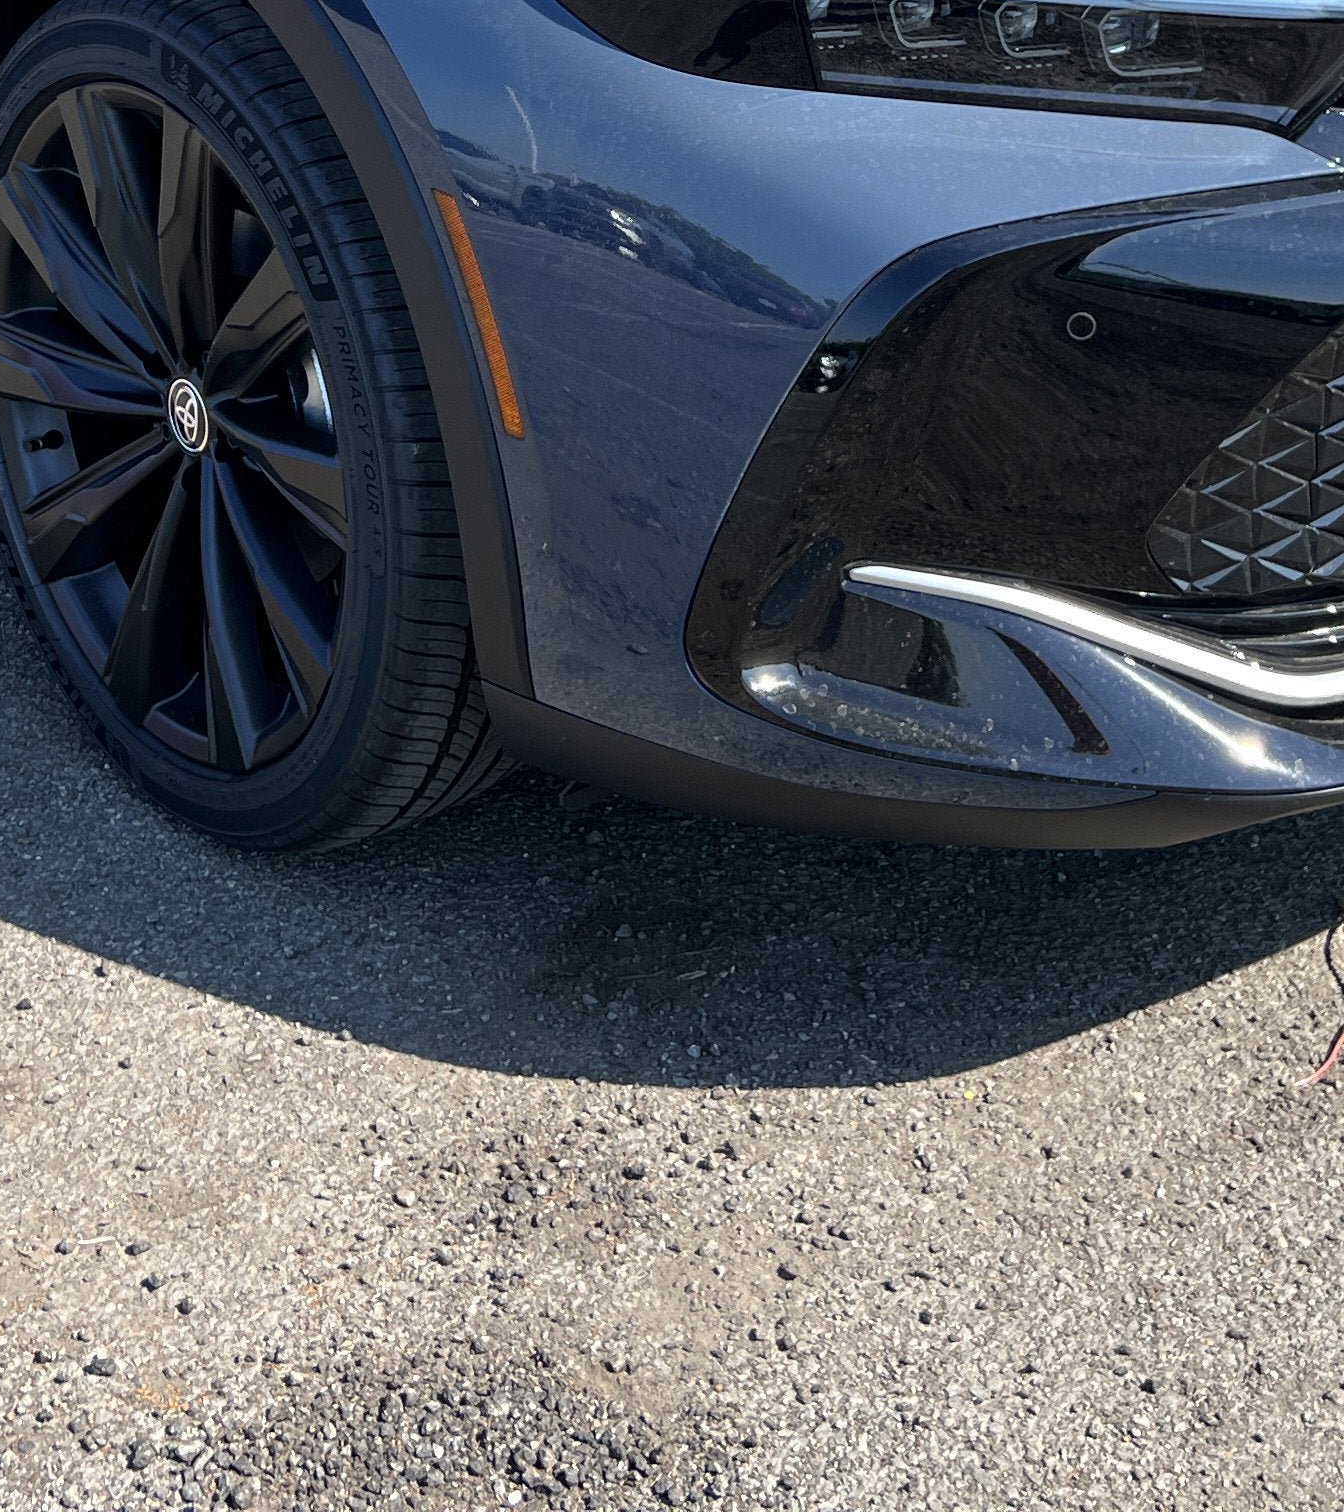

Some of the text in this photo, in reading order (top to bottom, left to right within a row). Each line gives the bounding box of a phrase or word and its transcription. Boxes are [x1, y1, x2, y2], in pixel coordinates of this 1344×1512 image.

[195, 82, 329, 287] MICHELIN
[332, 325, 370, 438] PRIMACY
[360, 448, 380, 516] TOUR
